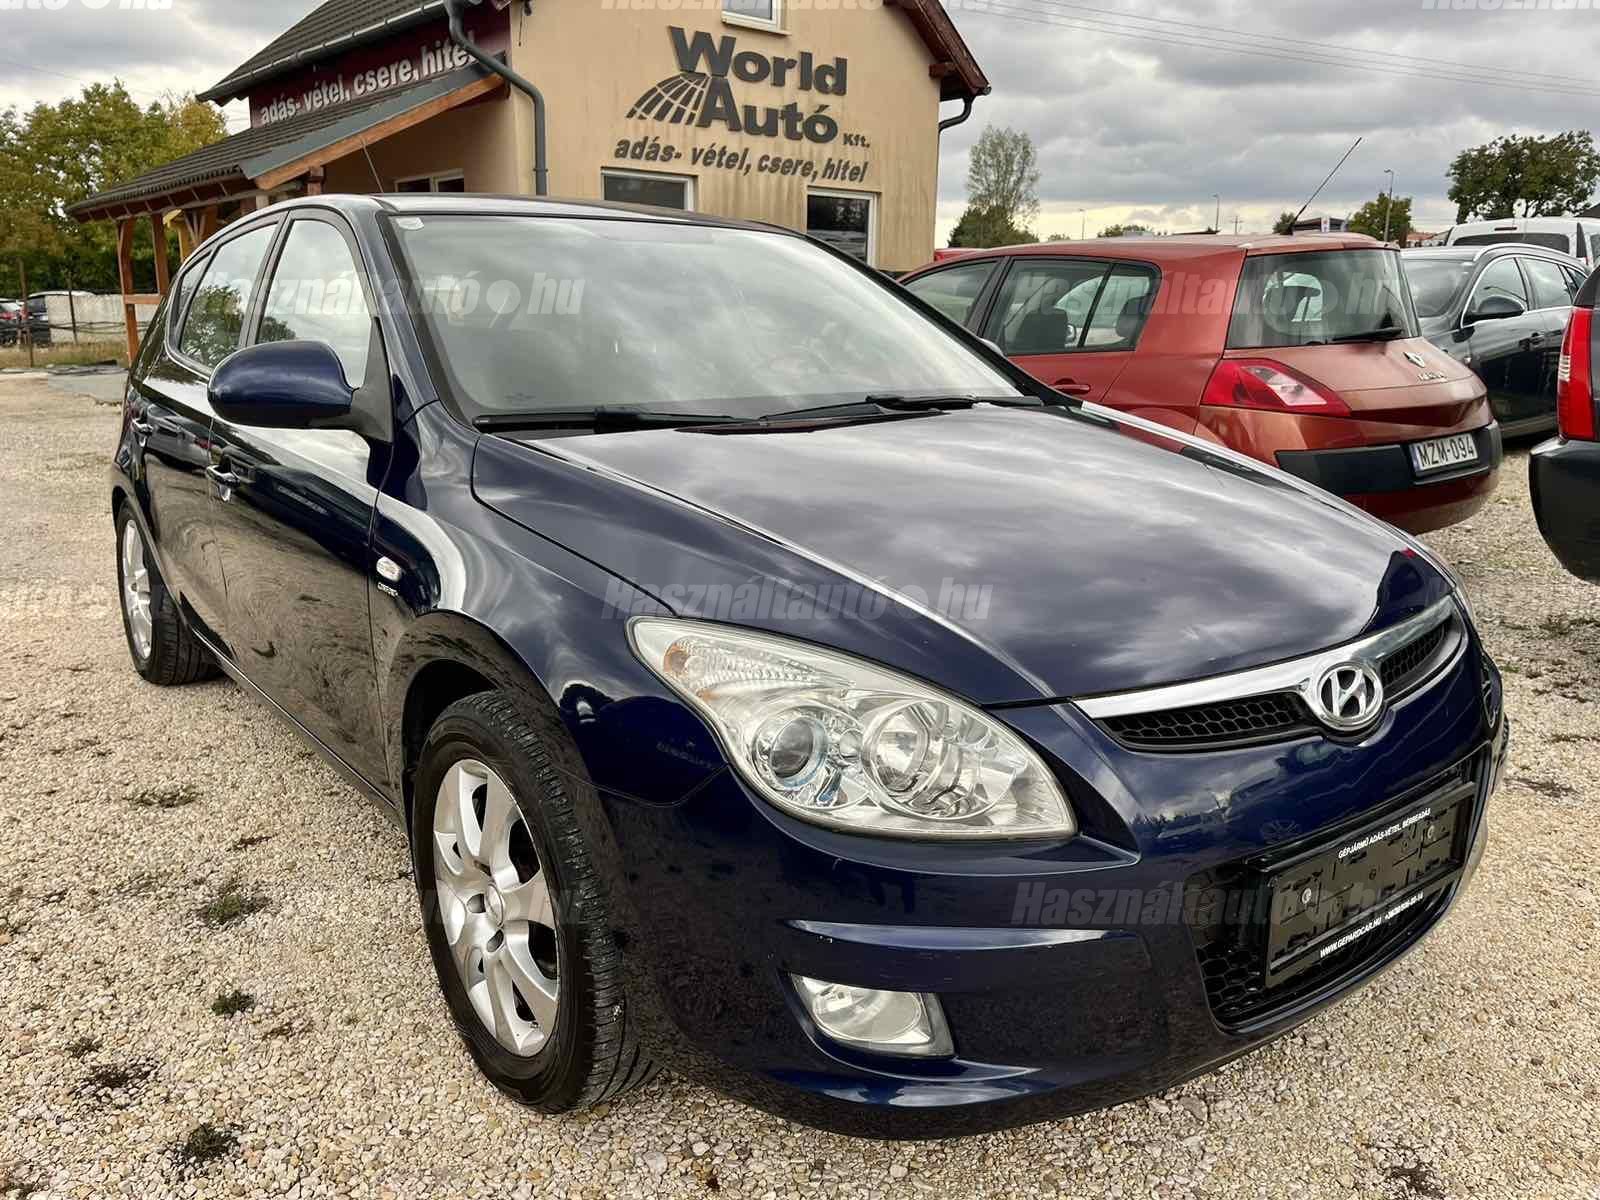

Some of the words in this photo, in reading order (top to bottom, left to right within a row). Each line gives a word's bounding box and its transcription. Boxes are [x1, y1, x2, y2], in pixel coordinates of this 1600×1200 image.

[260, 92, 302, 125] adás-
[303, 73, 351, 113] vétel,
[353, 60, 420, 96] csere,
[667, 25, 848, 96] World
[695, 76, 839, 144] Autó
[842, 132, 872, 148] Kft.
[613, 135, 683, 161] adás-
[689, 142, 753, 176] vétel,
[756, 151, 819, 183] csere,
[820, 156, 870, 184] hitel
[1417, 434, 1475, 467] MZM-094
